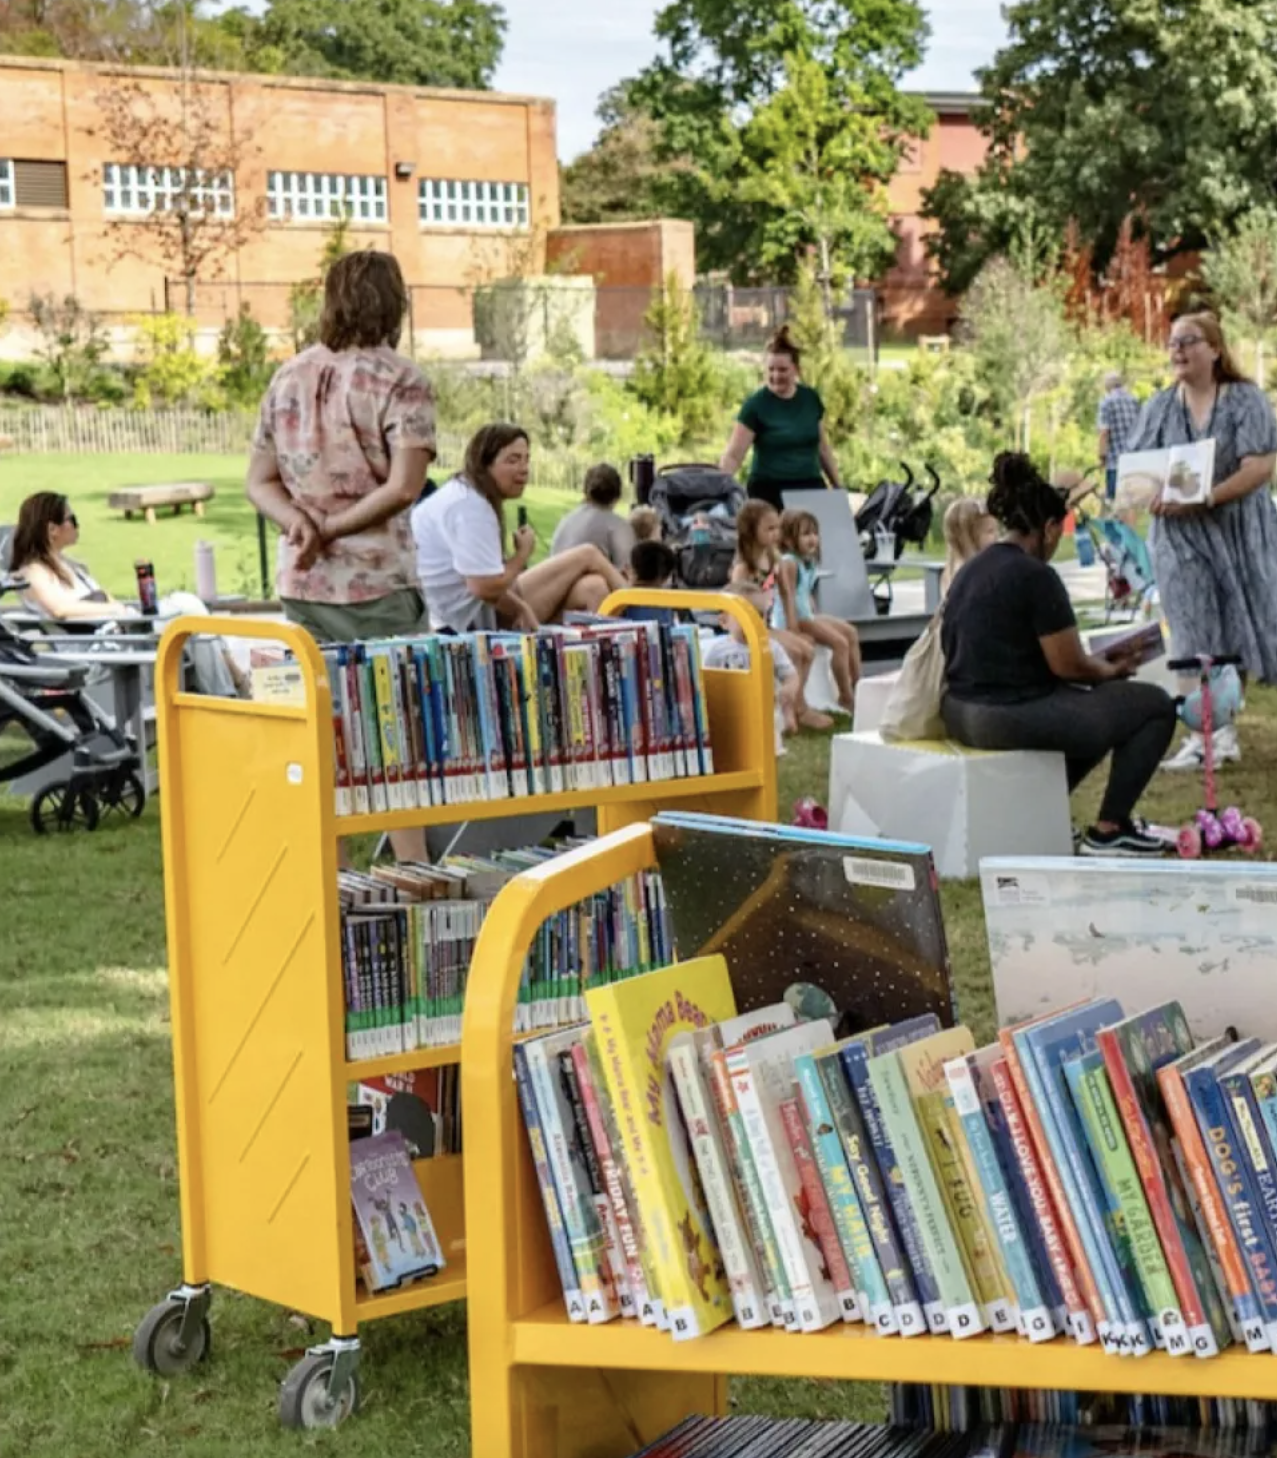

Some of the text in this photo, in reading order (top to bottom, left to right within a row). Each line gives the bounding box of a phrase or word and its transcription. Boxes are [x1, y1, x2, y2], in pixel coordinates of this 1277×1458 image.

[845, 1133, 890, 1245] Say Good Night
[1116, 1176, 1137, 1203] MY
[1208, 1125, 1243, 1196] DOG'S
[1232, 1199, 1260, 1247] first
[1013, 1136, 1035, 1178] LOVE
[1039, 1214, 1061, 1253] BABY
[603, 1157, 639, 1258] FRIDAY FUN
[990, 1190, 1018, 1243] WATER
[1124, 1203, 1164, 1276] GARDEN
[590, 1299, 602, 1313] A
[643, 1302, 654, 1316] A
[843, 1298, 855, 1311] B
[879, 1314, 890, 1327] C
[902, 1313, 913, 1326] D
[934, 1313, 945, 1326] D
[958, 1314, 970, 1327] D
[995, 1309, 1007, 1323] E
[675, 1318, 688, 1332] B
[1032, 1317, 1045, 1331] G
[1130, 1333, 1144, 1346] K
[1170, 1335, 1185, 1349] M
[1196, 1336, 1208, 1350] G
